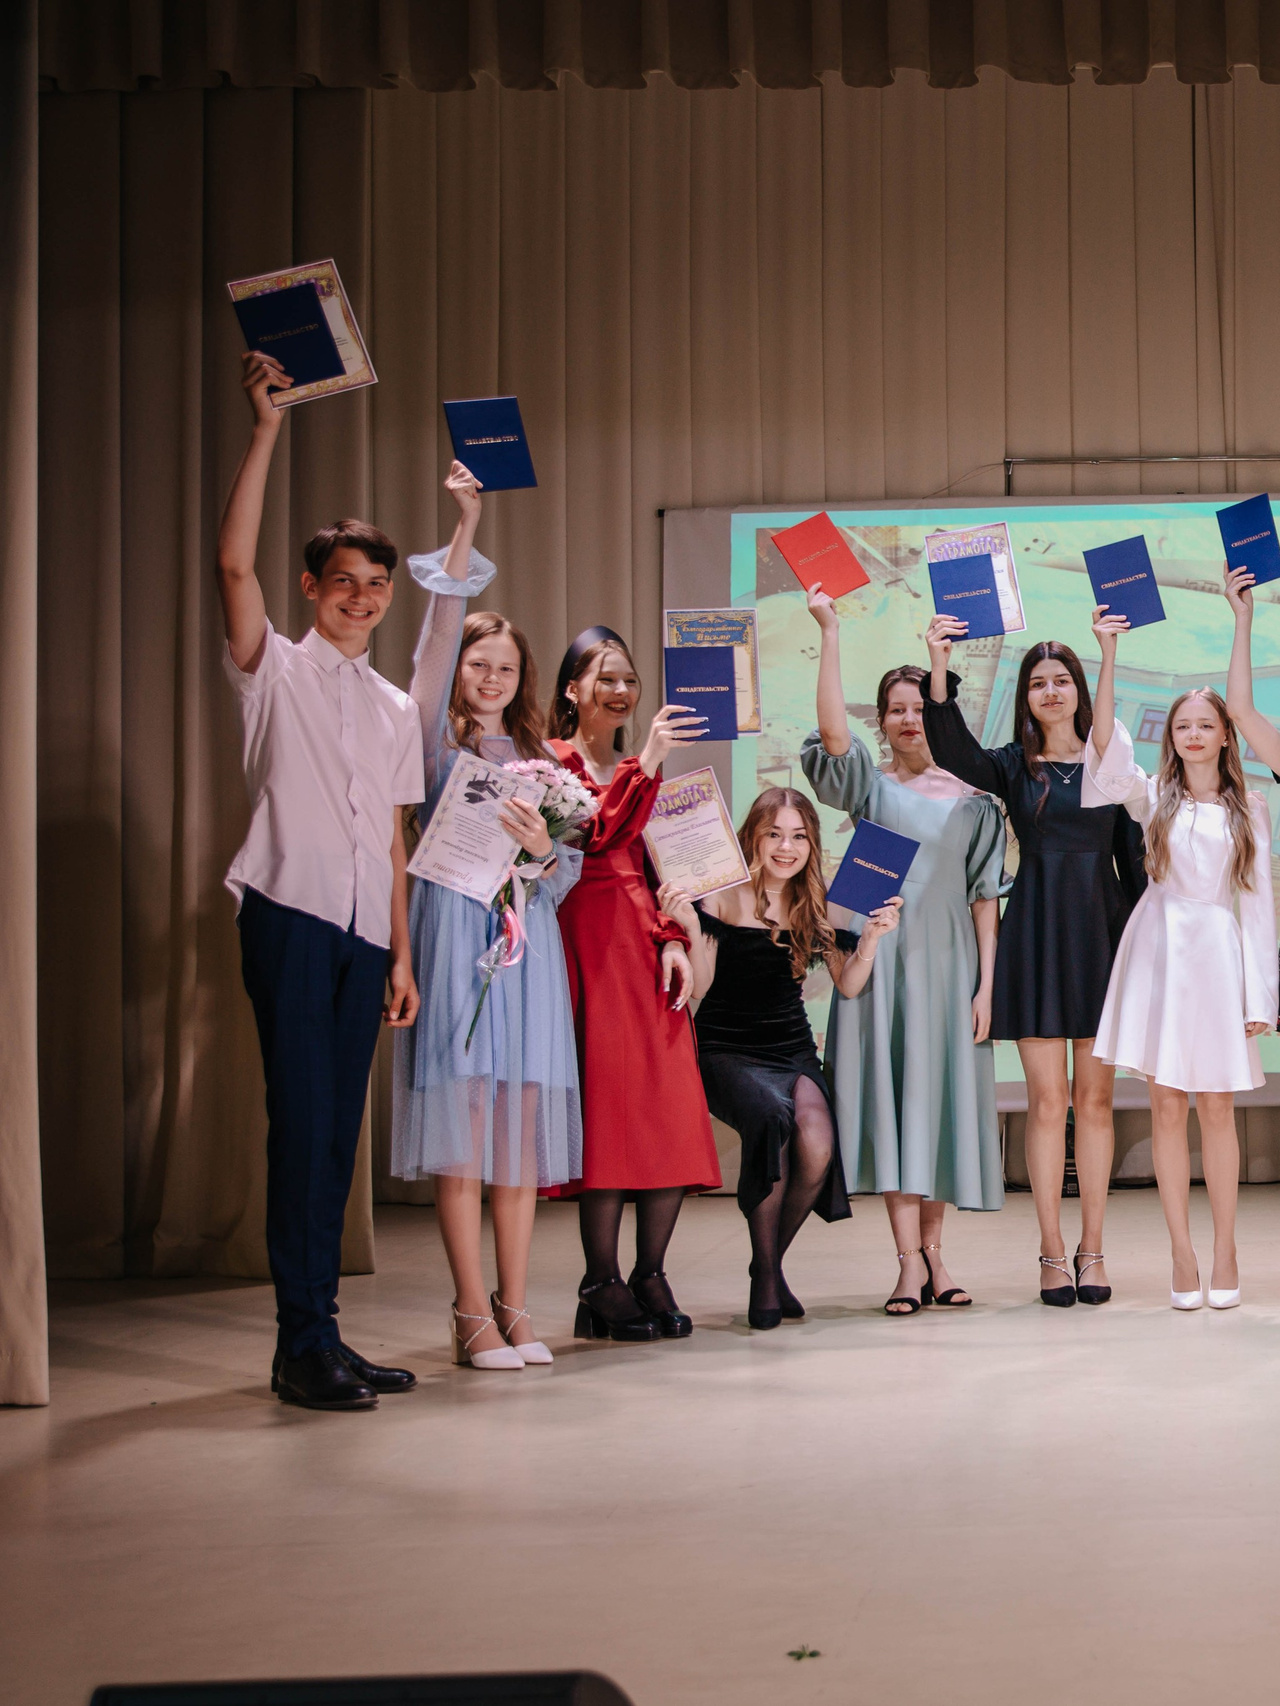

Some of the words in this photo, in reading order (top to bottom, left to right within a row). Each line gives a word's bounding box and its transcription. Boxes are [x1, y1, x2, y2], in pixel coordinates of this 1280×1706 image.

[1231, 530, 1270, 547] СВИДЕТЕЛЬСТВО
[948, 541, 992, 558] ГРАМОТА
[1101, 572, 1147, 589] СВИДЕТЕЛЬСТВО
[943, 588, 991, 600] СВИДЕТЕЛЬСТВО
[655, 789, 703, 815] ГРАМОТА
[853, 857, 899, 879] СВИДЕТЕЛЬСТВО
